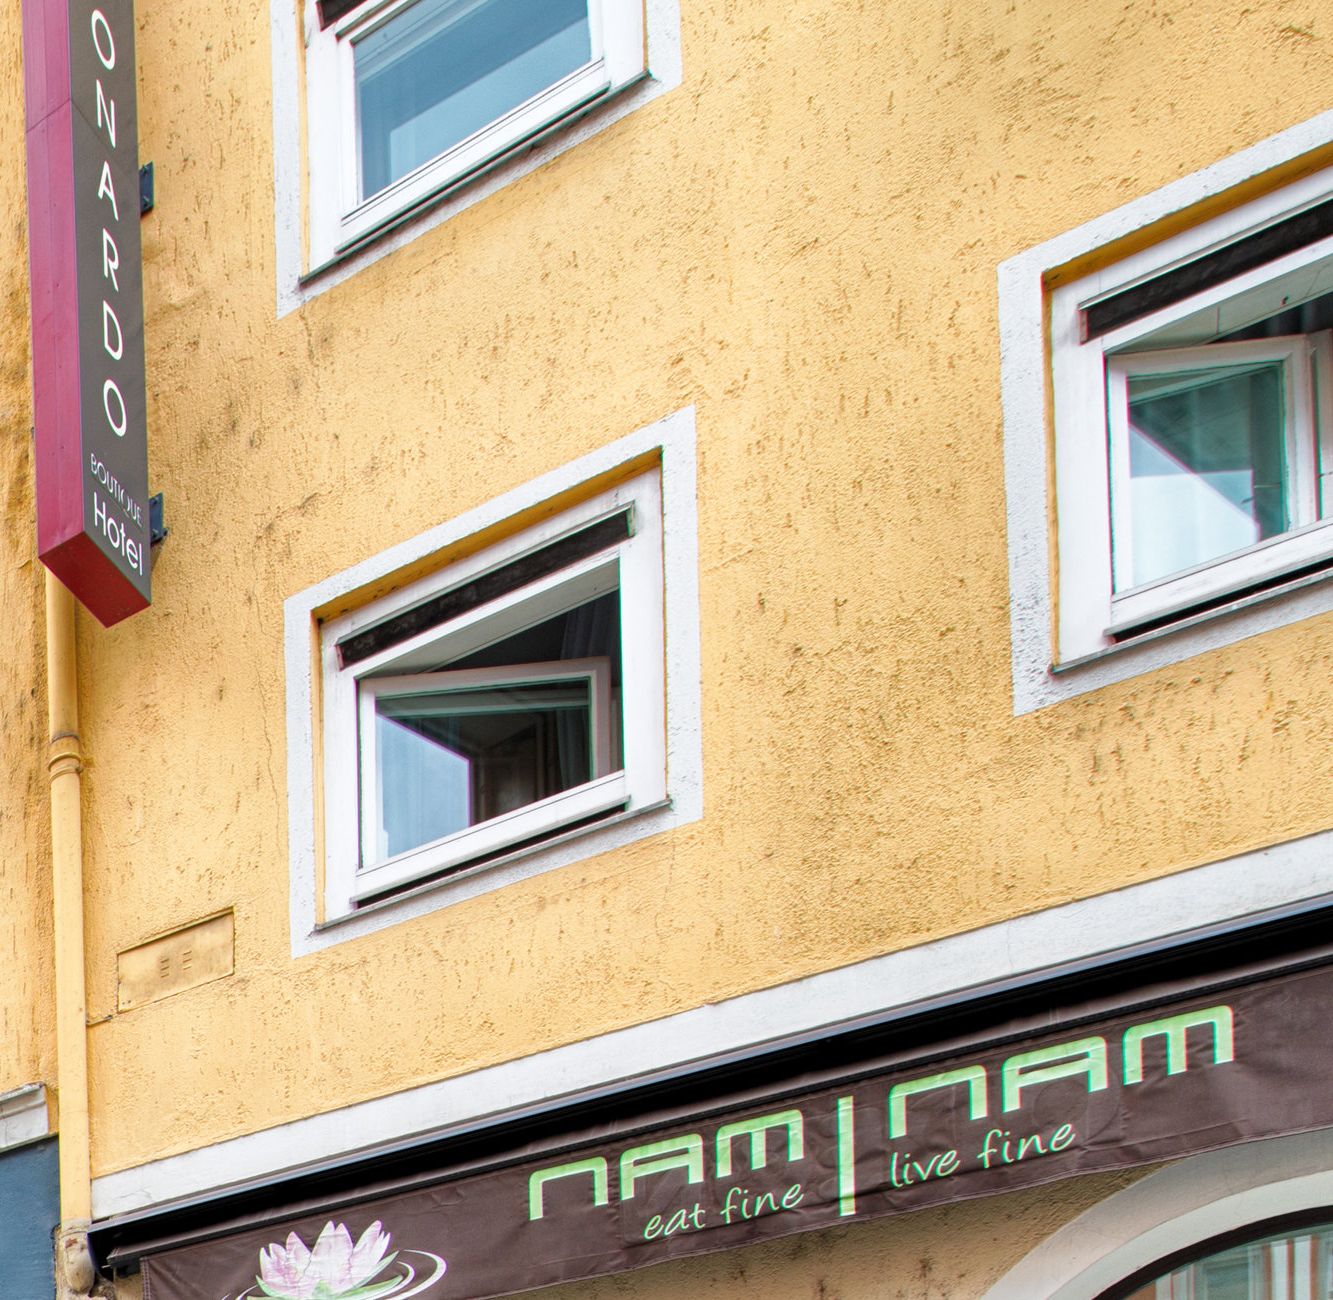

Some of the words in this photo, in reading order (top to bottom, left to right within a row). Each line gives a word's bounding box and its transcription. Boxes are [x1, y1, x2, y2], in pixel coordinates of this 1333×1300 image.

[90, 452, 142, 528] BOUTIQUE
[94, 491, 143, 576] Hotel
[890, 1149, 961, 1188] live
[976, 1123, 1076, 1169] fine
[643, 1203, 706, 1240] eat
[719, 1183, 805, 1224] fine
